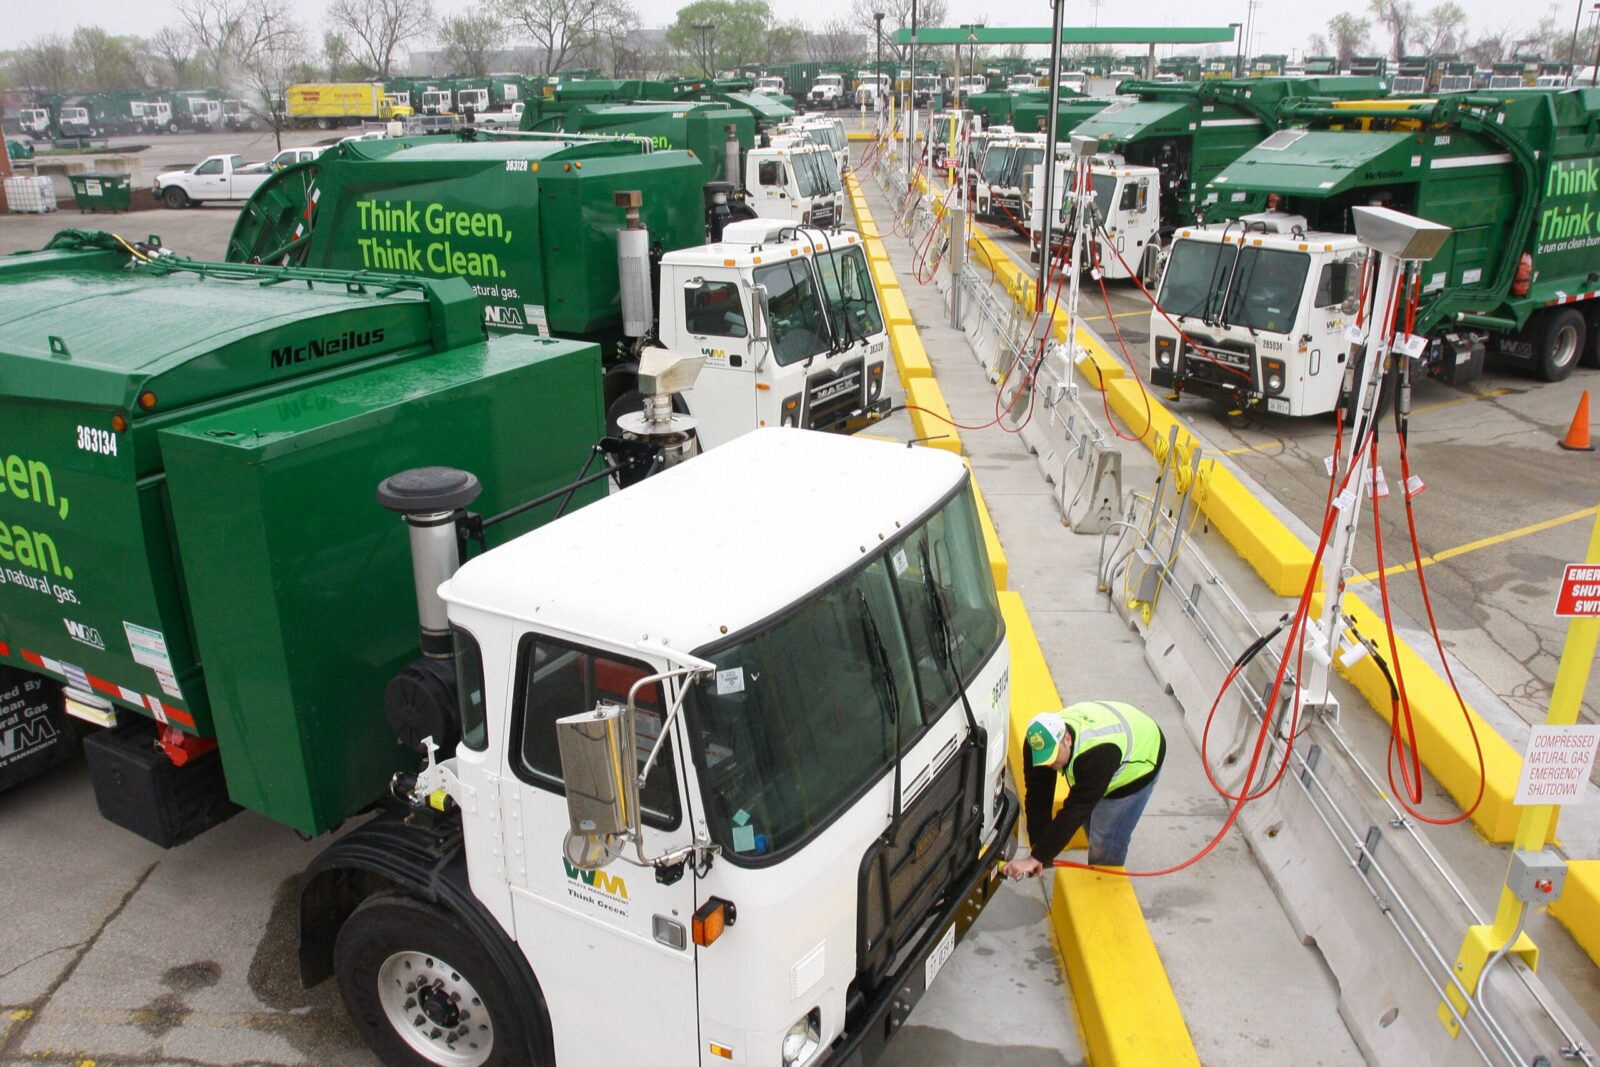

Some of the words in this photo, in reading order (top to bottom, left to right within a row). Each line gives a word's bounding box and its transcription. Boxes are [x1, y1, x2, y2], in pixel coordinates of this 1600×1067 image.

[356, 199, 421, 233] Think
[425, 203, 513, 244] Green,
[357, 238, 425, 272] Think
[426, 242, 506, 278] Clean.
[472, 284, 499, 297] atural
[501, 288, 520, 300] gas.
[271, 328, 385, 369] McNeilus
[701, 348, 726, 358] WM
[1263, 340, 1283, 351] 265034
[817, 379, 855, 399] MACK
[77, 425, 117, 456] 363134
[6, 567, 51, 596] natural
[53, 584, 81, 605] gas.
[64, 618, 106, 648] WM
[24, 680, 41, 691] By
[24, 703, 48, 718] Gas
[9, 738, 58, 763] MANAGEMENT
[1534, 735, 1595, 748] COMPRESSED
[1528, 752, 1569, 764] NATURAL
[1571, 751, 1590, 764] GAS
[1529, 767, 1584, 780] EMERGENCY
[1527, 783, 1578, 796] SHUTDOWN
[562, 856, 629, 900] WM
[567, 879, 587, 890] WASTE
[587, 887, 629, 906] MANAGEMENT
[567, 888, 595, 905] Think
